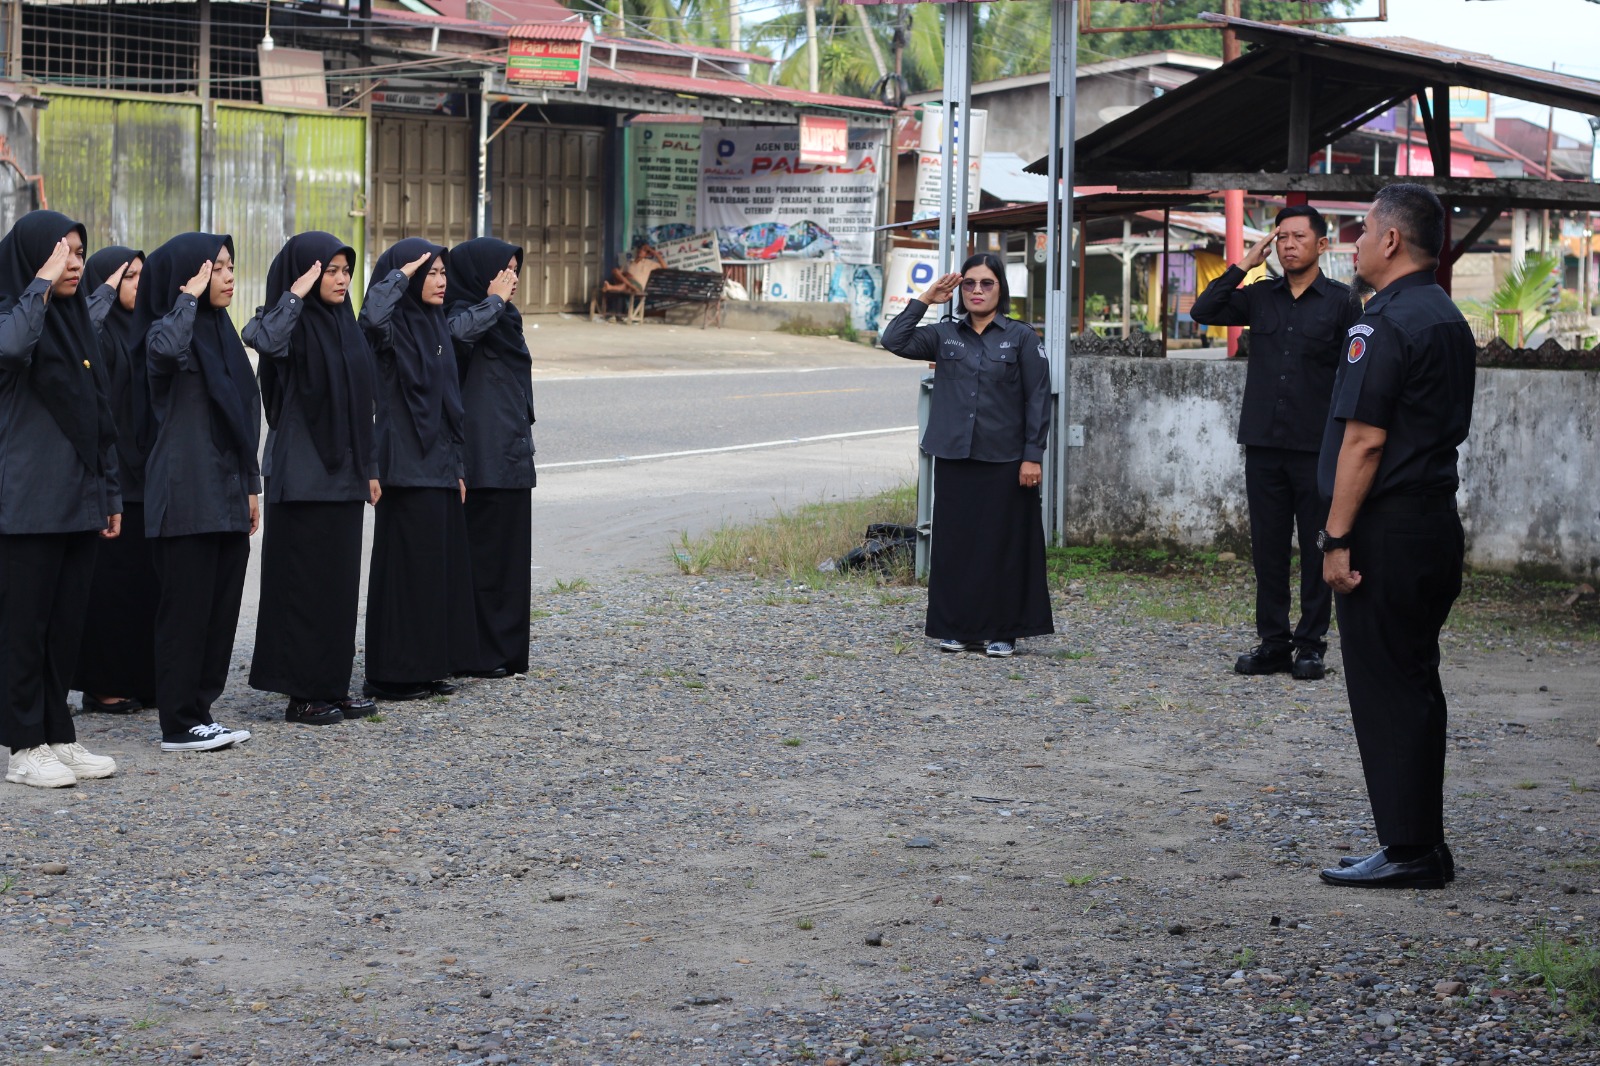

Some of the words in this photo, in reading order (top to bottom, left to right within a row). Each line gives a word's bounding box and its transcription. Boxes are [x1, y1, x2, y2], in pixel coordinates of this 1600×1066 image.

[521, 40, 546, 56] Fajar
[547, 41, 579, 55] Teknik
[755, 143, 781, 151] AGEN
[776, 186, 801, 194] PONDOK
[836, 196, 872, 204] KARAWANG
[944, 339, 965, 348] JUNITA
